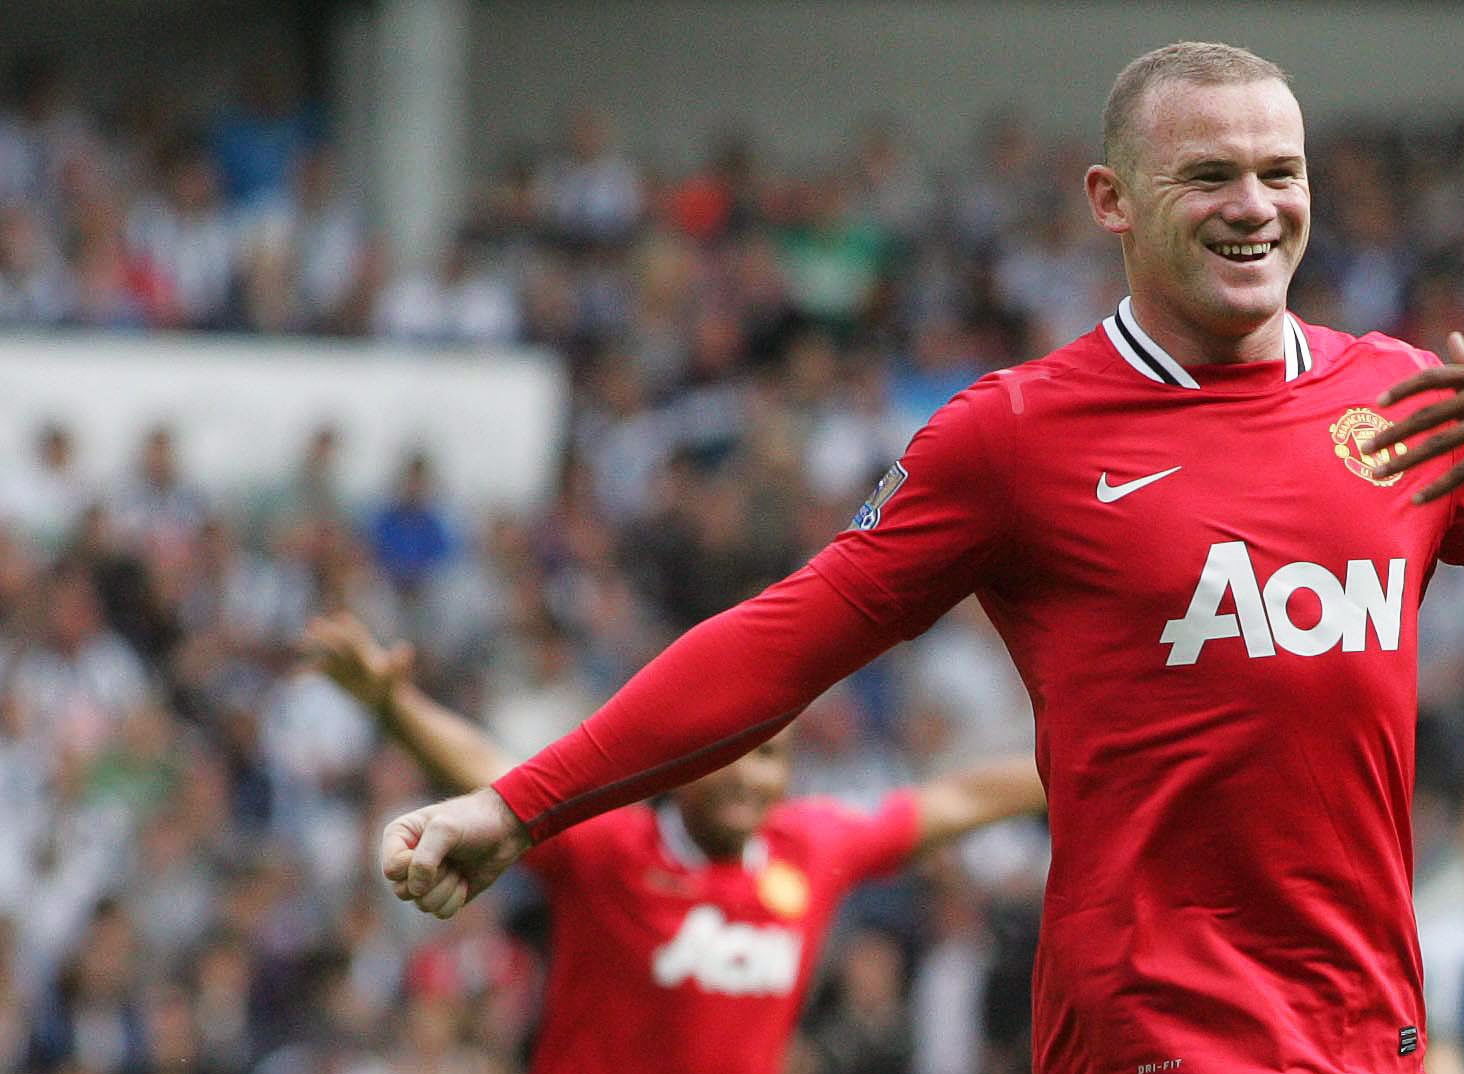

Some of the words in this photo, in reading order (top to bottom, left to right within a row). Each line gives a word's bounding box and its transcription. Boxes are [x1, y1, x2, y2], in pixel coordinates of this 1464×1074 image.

[1335, 413, 1391, 441] MANCHEST
[1159, 541, 1407, 666] AON
[1138, 1058, 1183, 1074] DRI-FIT
